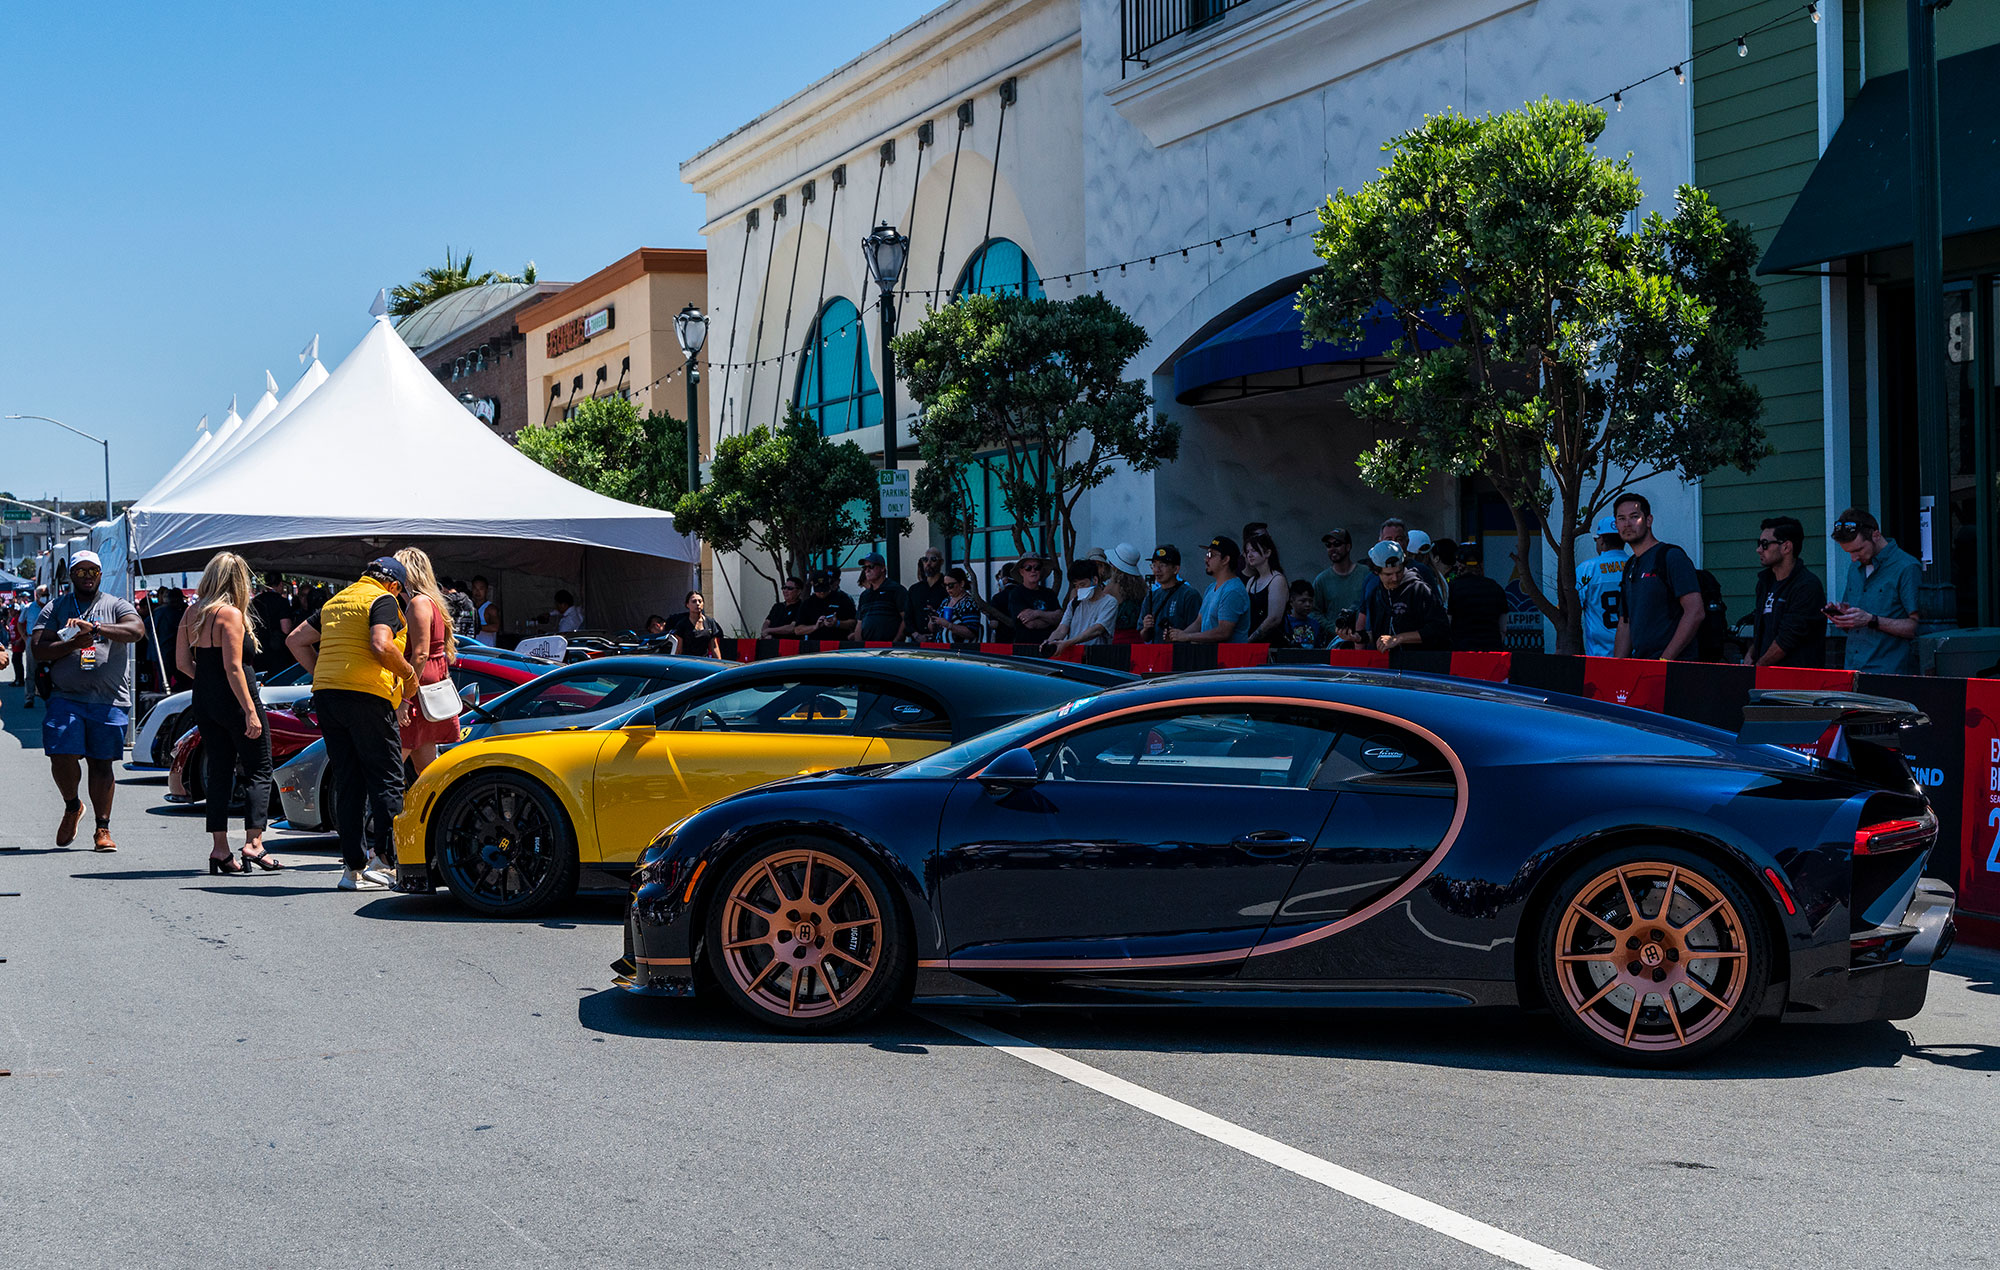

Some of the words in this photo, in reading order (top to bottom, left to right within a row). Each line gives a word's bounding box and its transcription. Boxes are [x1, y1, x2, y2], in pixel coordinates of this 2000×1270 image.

[883, 473, 891, 483] 20
[895, 472, 907, 482] MIN
[882, 488, 908, 497] PARKING
[887, 503, 904, 512] ONLY
[1506, 614, 1541, 625] LFPIPE
[1602, 909, 1618, 922] ATTI
[849, 927, 859, 951] UGATTI
